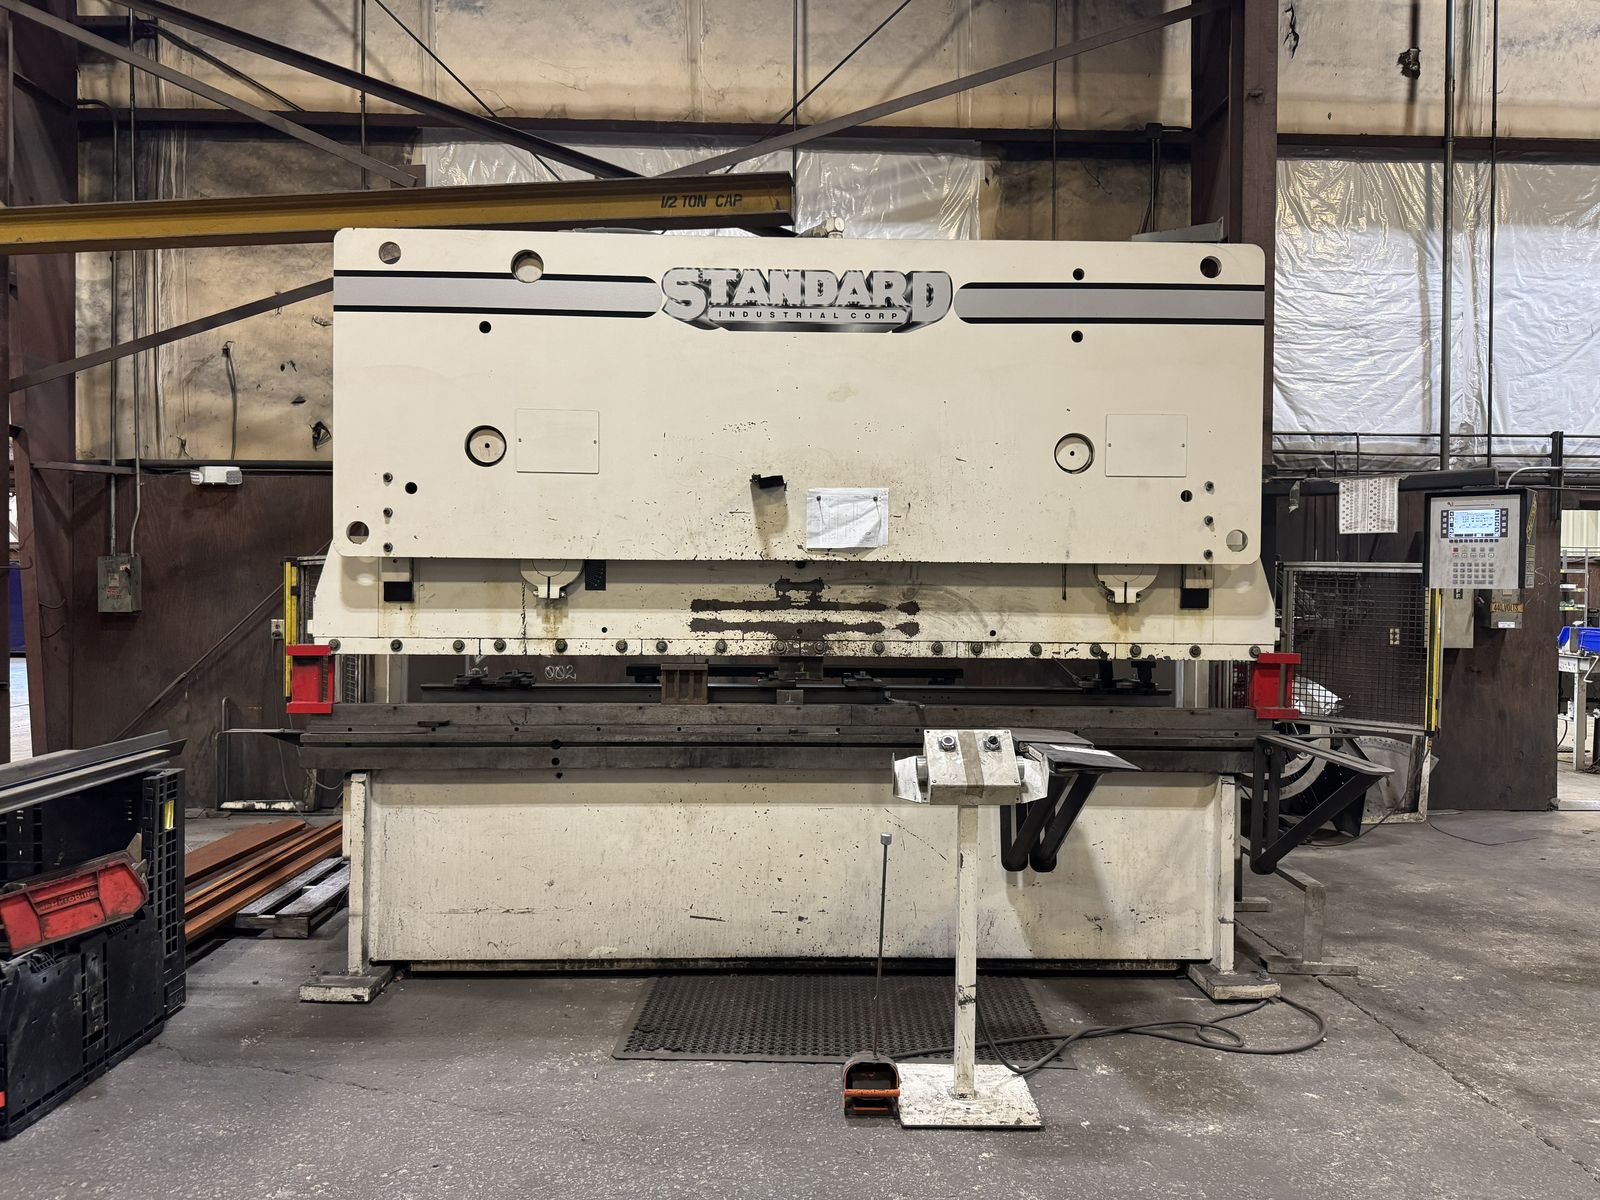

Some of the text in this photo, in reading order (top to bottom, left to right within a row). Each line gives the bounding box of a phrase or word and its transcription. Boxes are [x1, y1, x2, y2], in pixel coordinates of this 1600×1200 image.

[661, 193, 743, 208] 1/2 TON CAP
[661, 267, 953, 322] STANDARD
[718, 311, 898, 320] INDUSTRIAL CORP
[544, 664, 577, 681] 002
